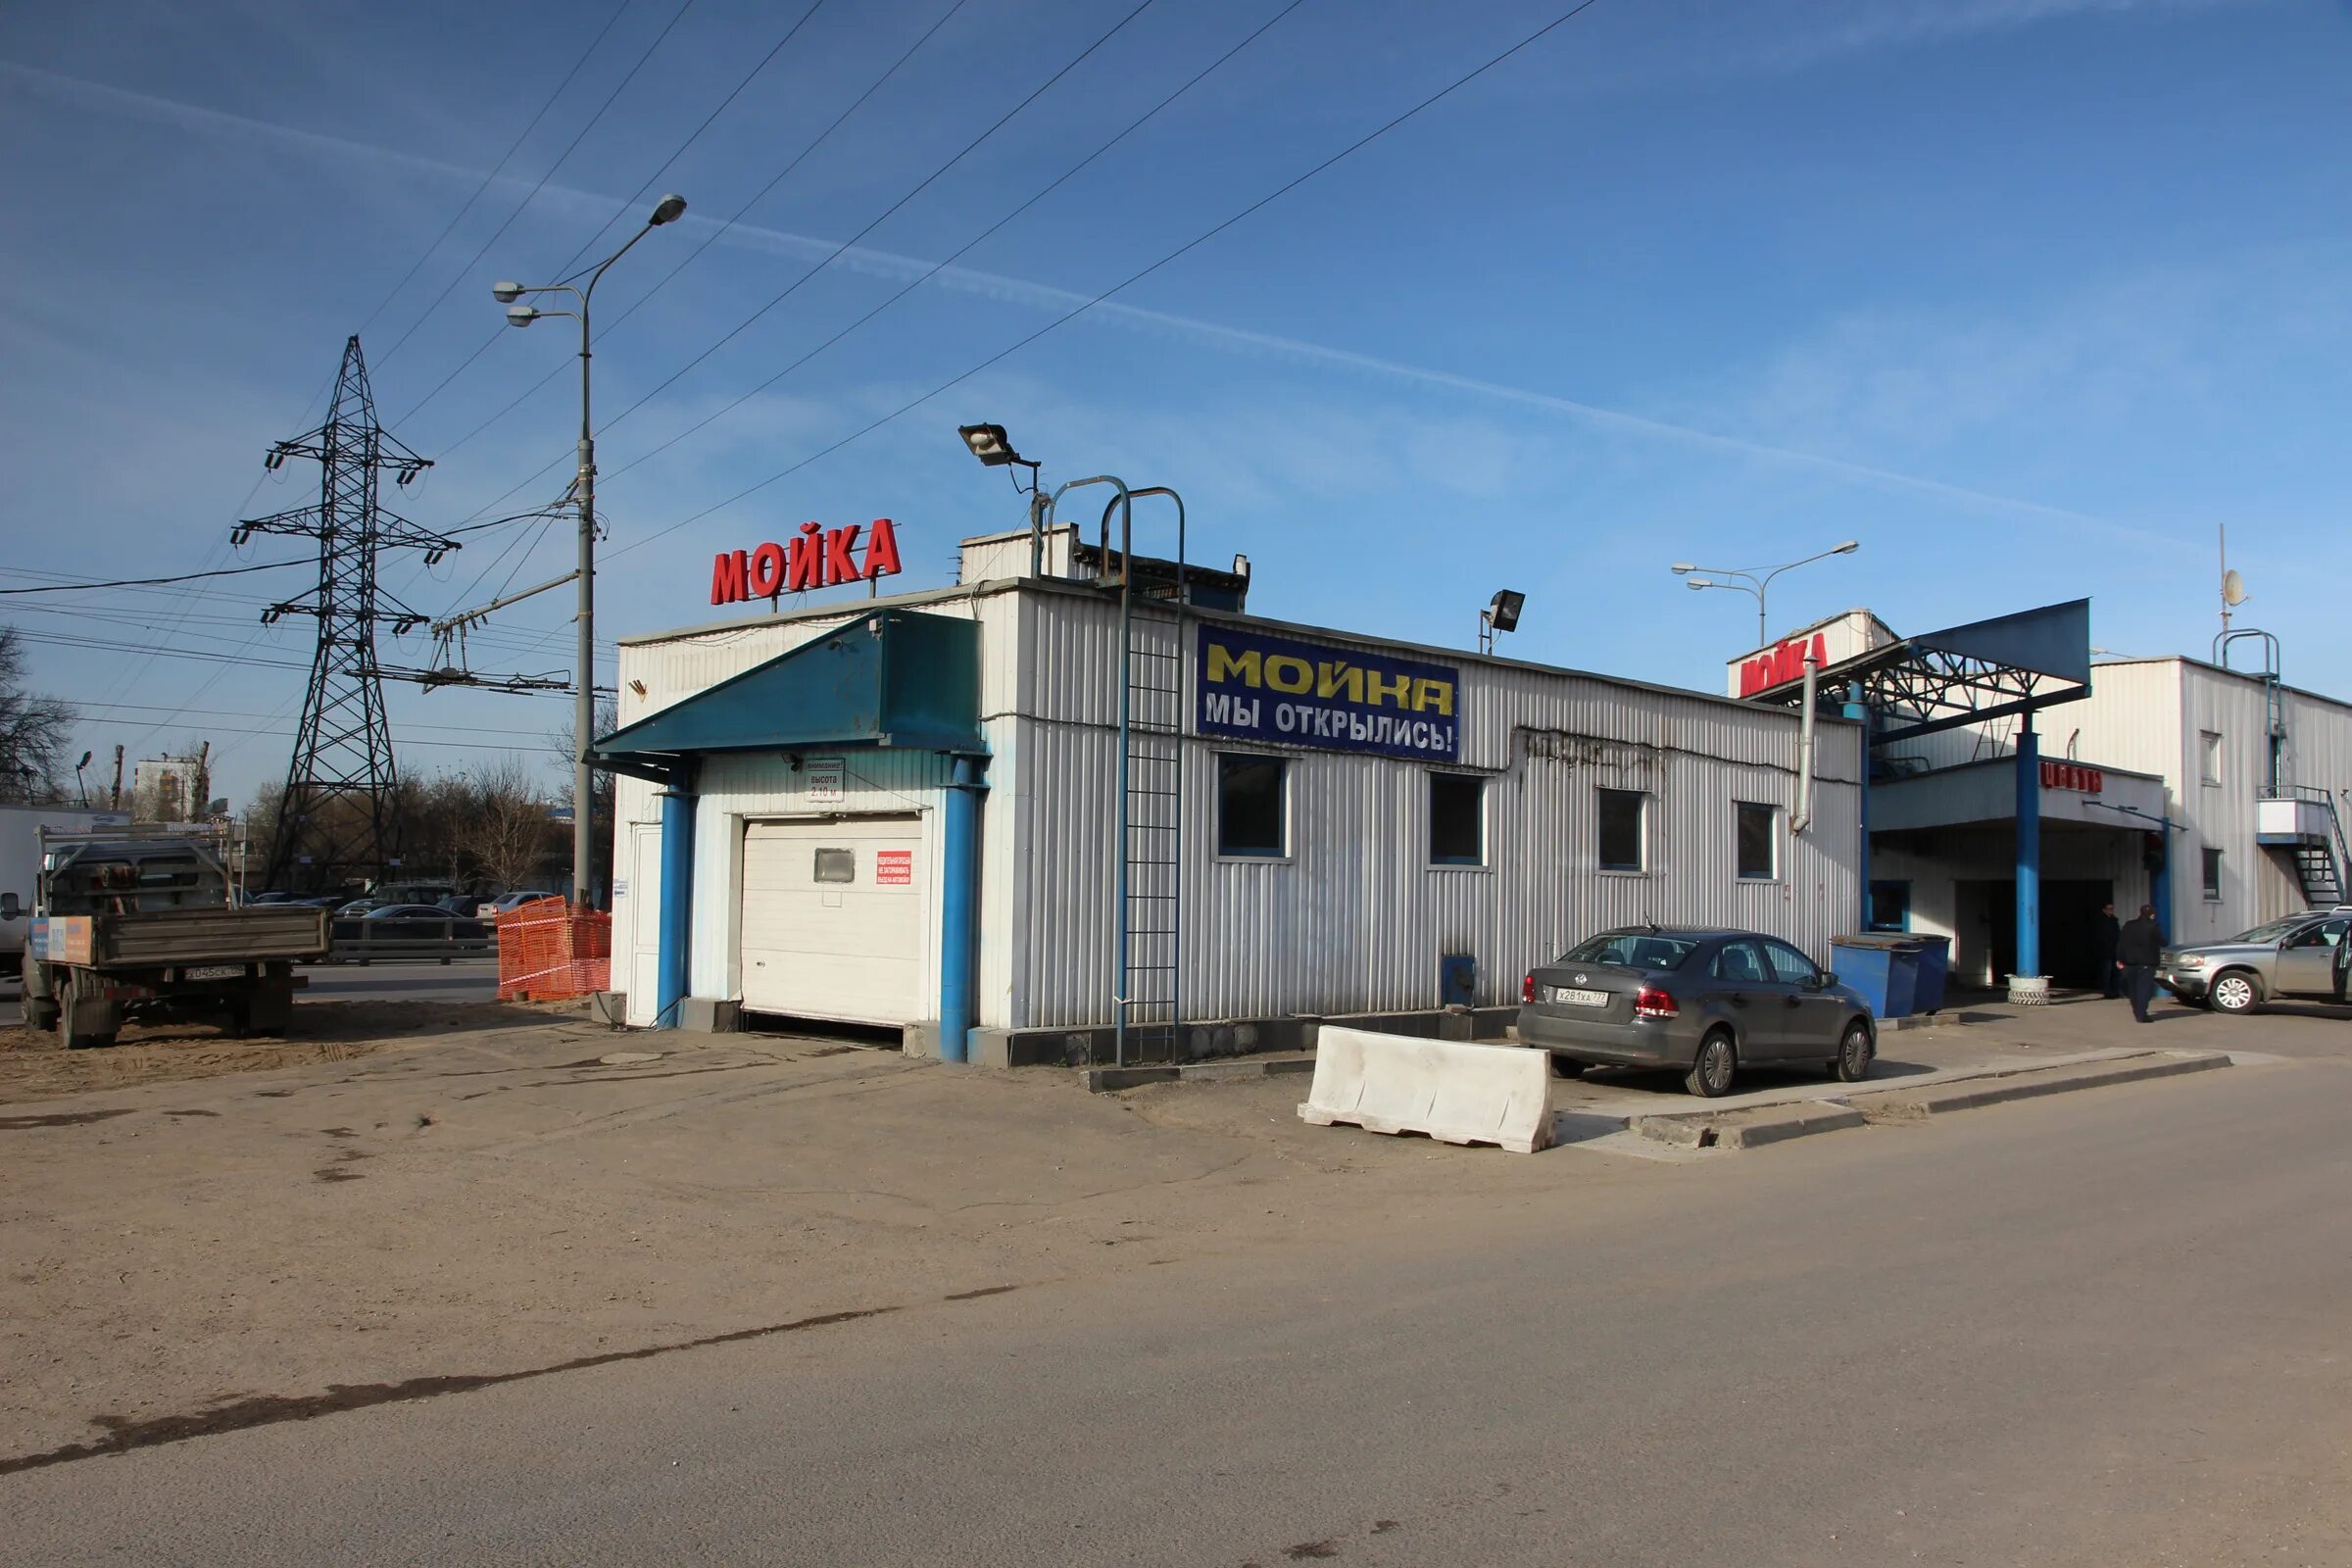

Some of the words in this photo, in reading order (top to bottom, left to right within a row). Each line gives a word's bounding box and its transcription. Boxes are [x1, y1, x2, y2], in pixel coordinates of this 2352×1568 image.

[710, 517, 902, 605] МОЙКА
[1206, 643, 1453, 716] МОЙКА
[1205, 692, 1259, 728] МЫ
[1275, 703, 1452, 753] ОТКРЫЛИСЬ!
